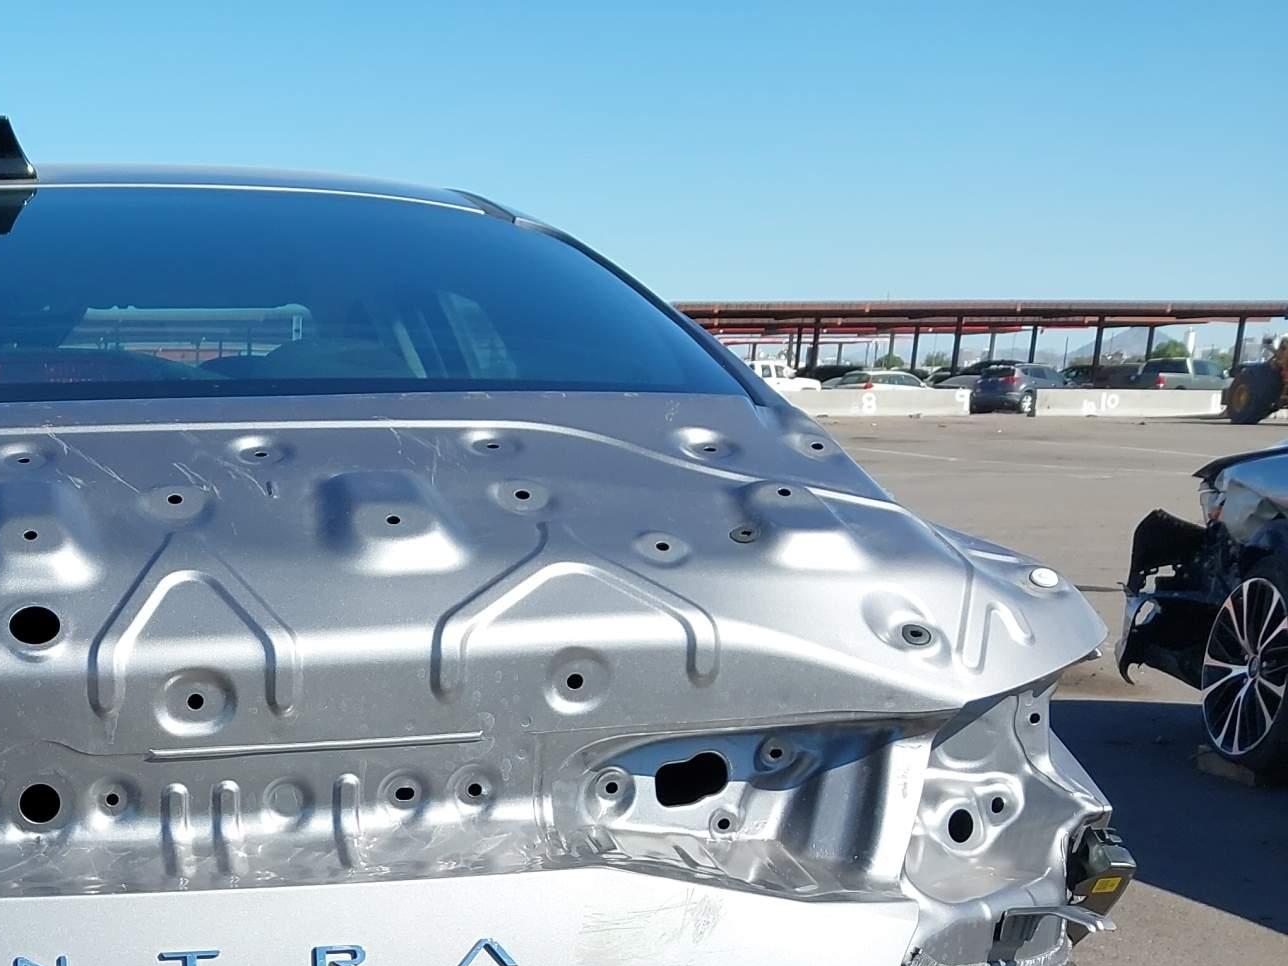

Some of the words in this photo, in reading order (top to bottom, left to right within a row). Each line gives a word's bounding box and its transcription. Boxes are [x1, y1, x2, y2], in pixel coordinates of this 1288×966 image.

[862, 391, 877, 414] 8
[955, 389, 971, 413] 9
[1100, 391, 1120, 413] 10
